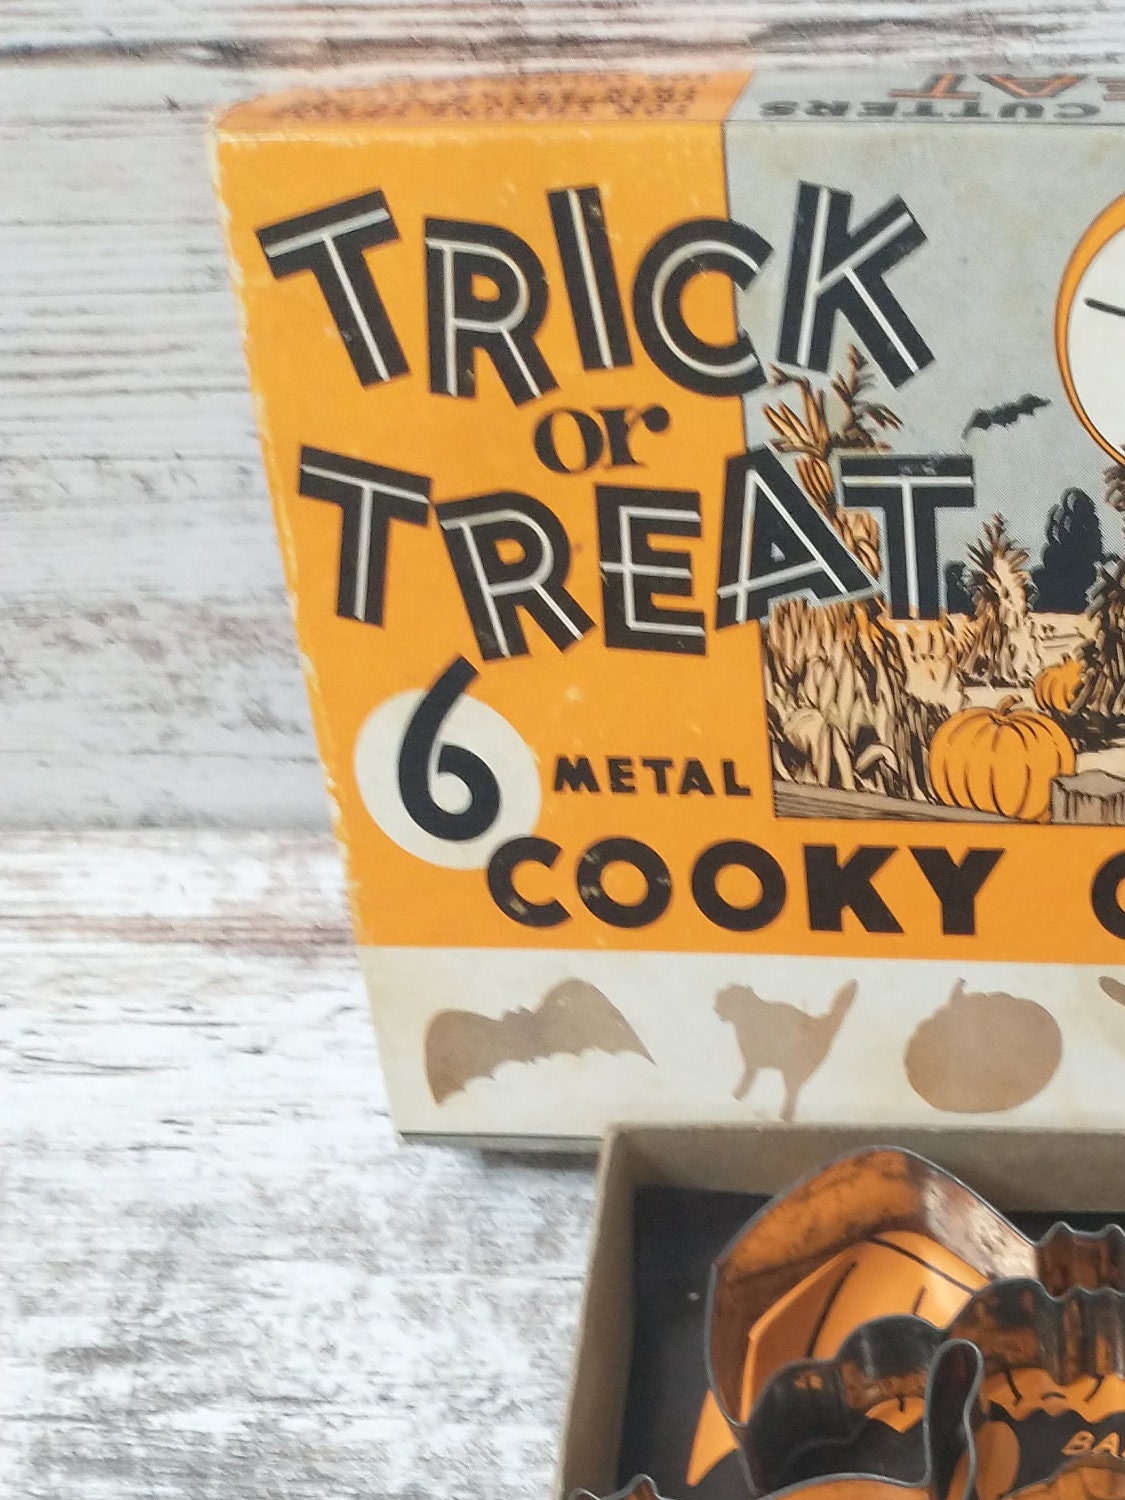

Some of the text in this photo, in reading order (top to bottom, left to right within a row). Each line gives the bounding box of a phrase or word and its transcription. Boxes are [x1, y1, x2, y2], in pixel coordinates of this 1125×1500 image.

[759, 99, 1102, 120] CUTTERS
[254, 181, 936, 406] TRICK
[533, 404, 670, 474] or
[299, 441, 975, 661] TREAT
[399, 655, 752, 842] 6 METAL
[487, 836, 1006, 936] COOKY
